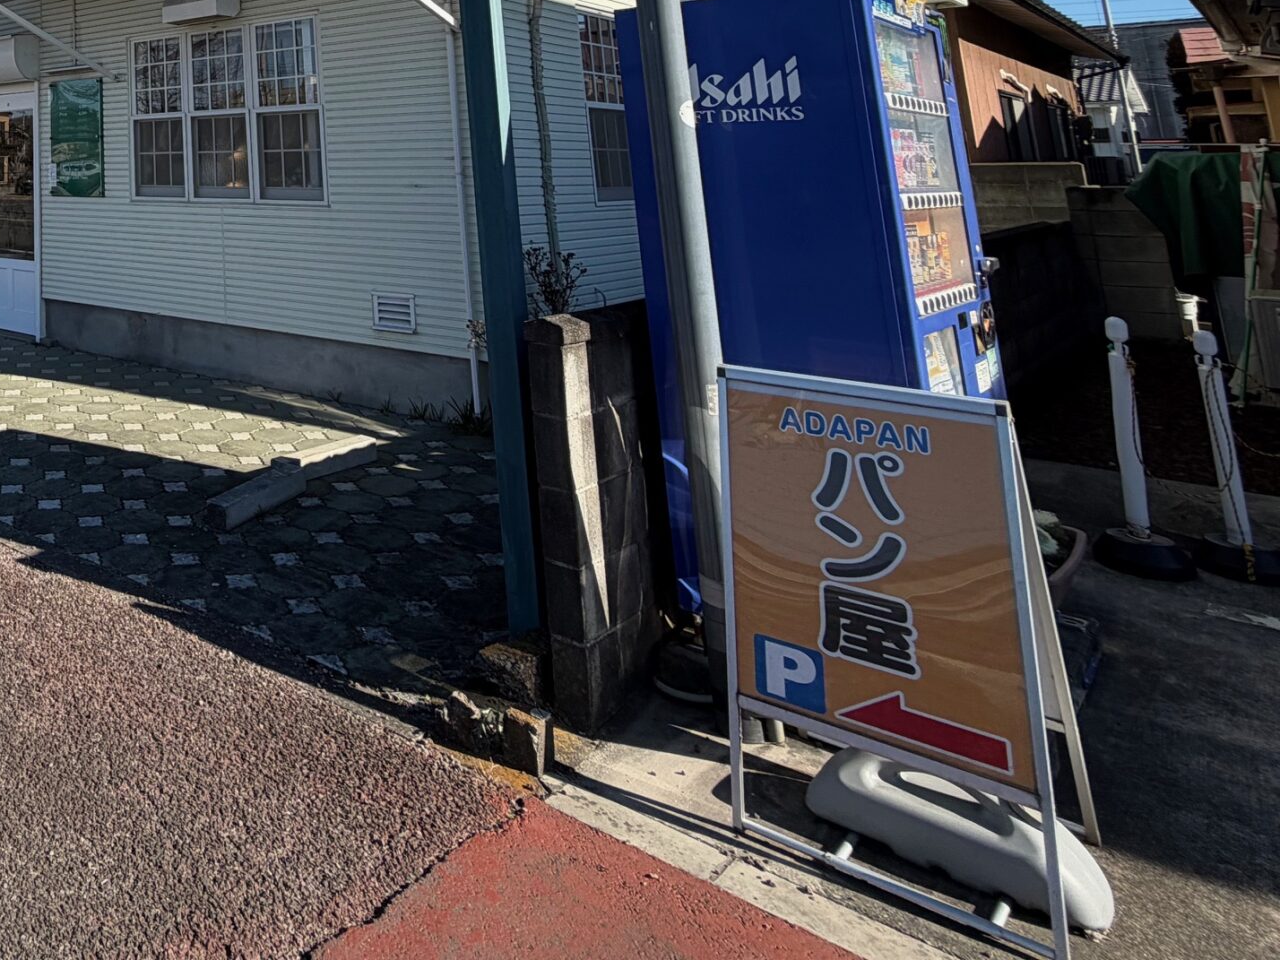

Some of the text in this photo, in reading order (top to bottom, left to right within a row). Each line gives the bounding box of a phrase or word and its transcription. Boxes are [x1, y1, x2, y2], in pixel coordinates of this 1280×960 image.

[695, 106, 805, 124] FT DRINKS
[779, 407, 930, 455] ADAPAN
[811, 448, 920, 680] パン屋
[764, 640, 817, 700] P
